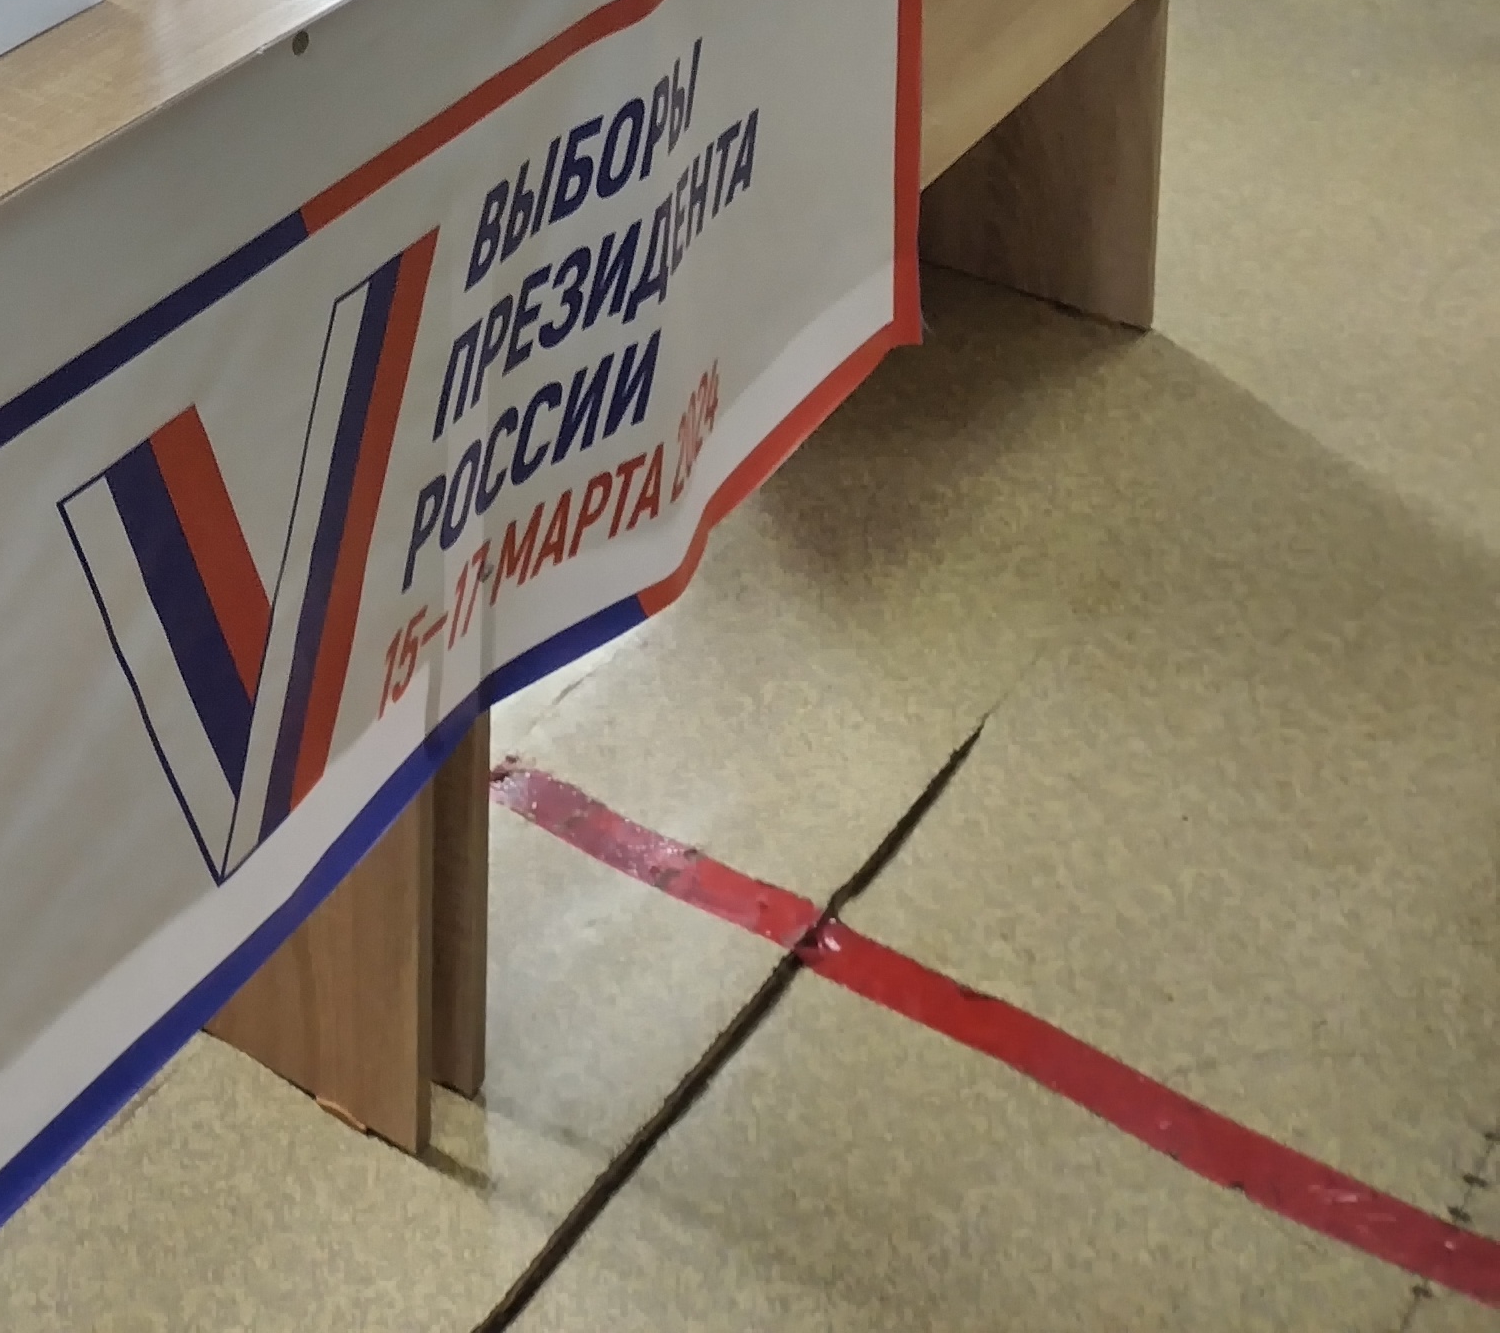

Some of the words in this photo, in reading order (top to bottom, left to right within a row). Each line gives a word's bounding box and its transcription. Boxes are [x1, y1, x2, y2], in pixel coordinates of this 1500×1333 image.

[432, 108, 759, 443] ПРЕЗИДЕНТА
[464, 36, 702, 292] ВЫБОРЫ
[400, 329, 661, 594] РОССИИ
[489, 443, 665, 608] МАРТА
[671, 358, 720, 506] 2024
